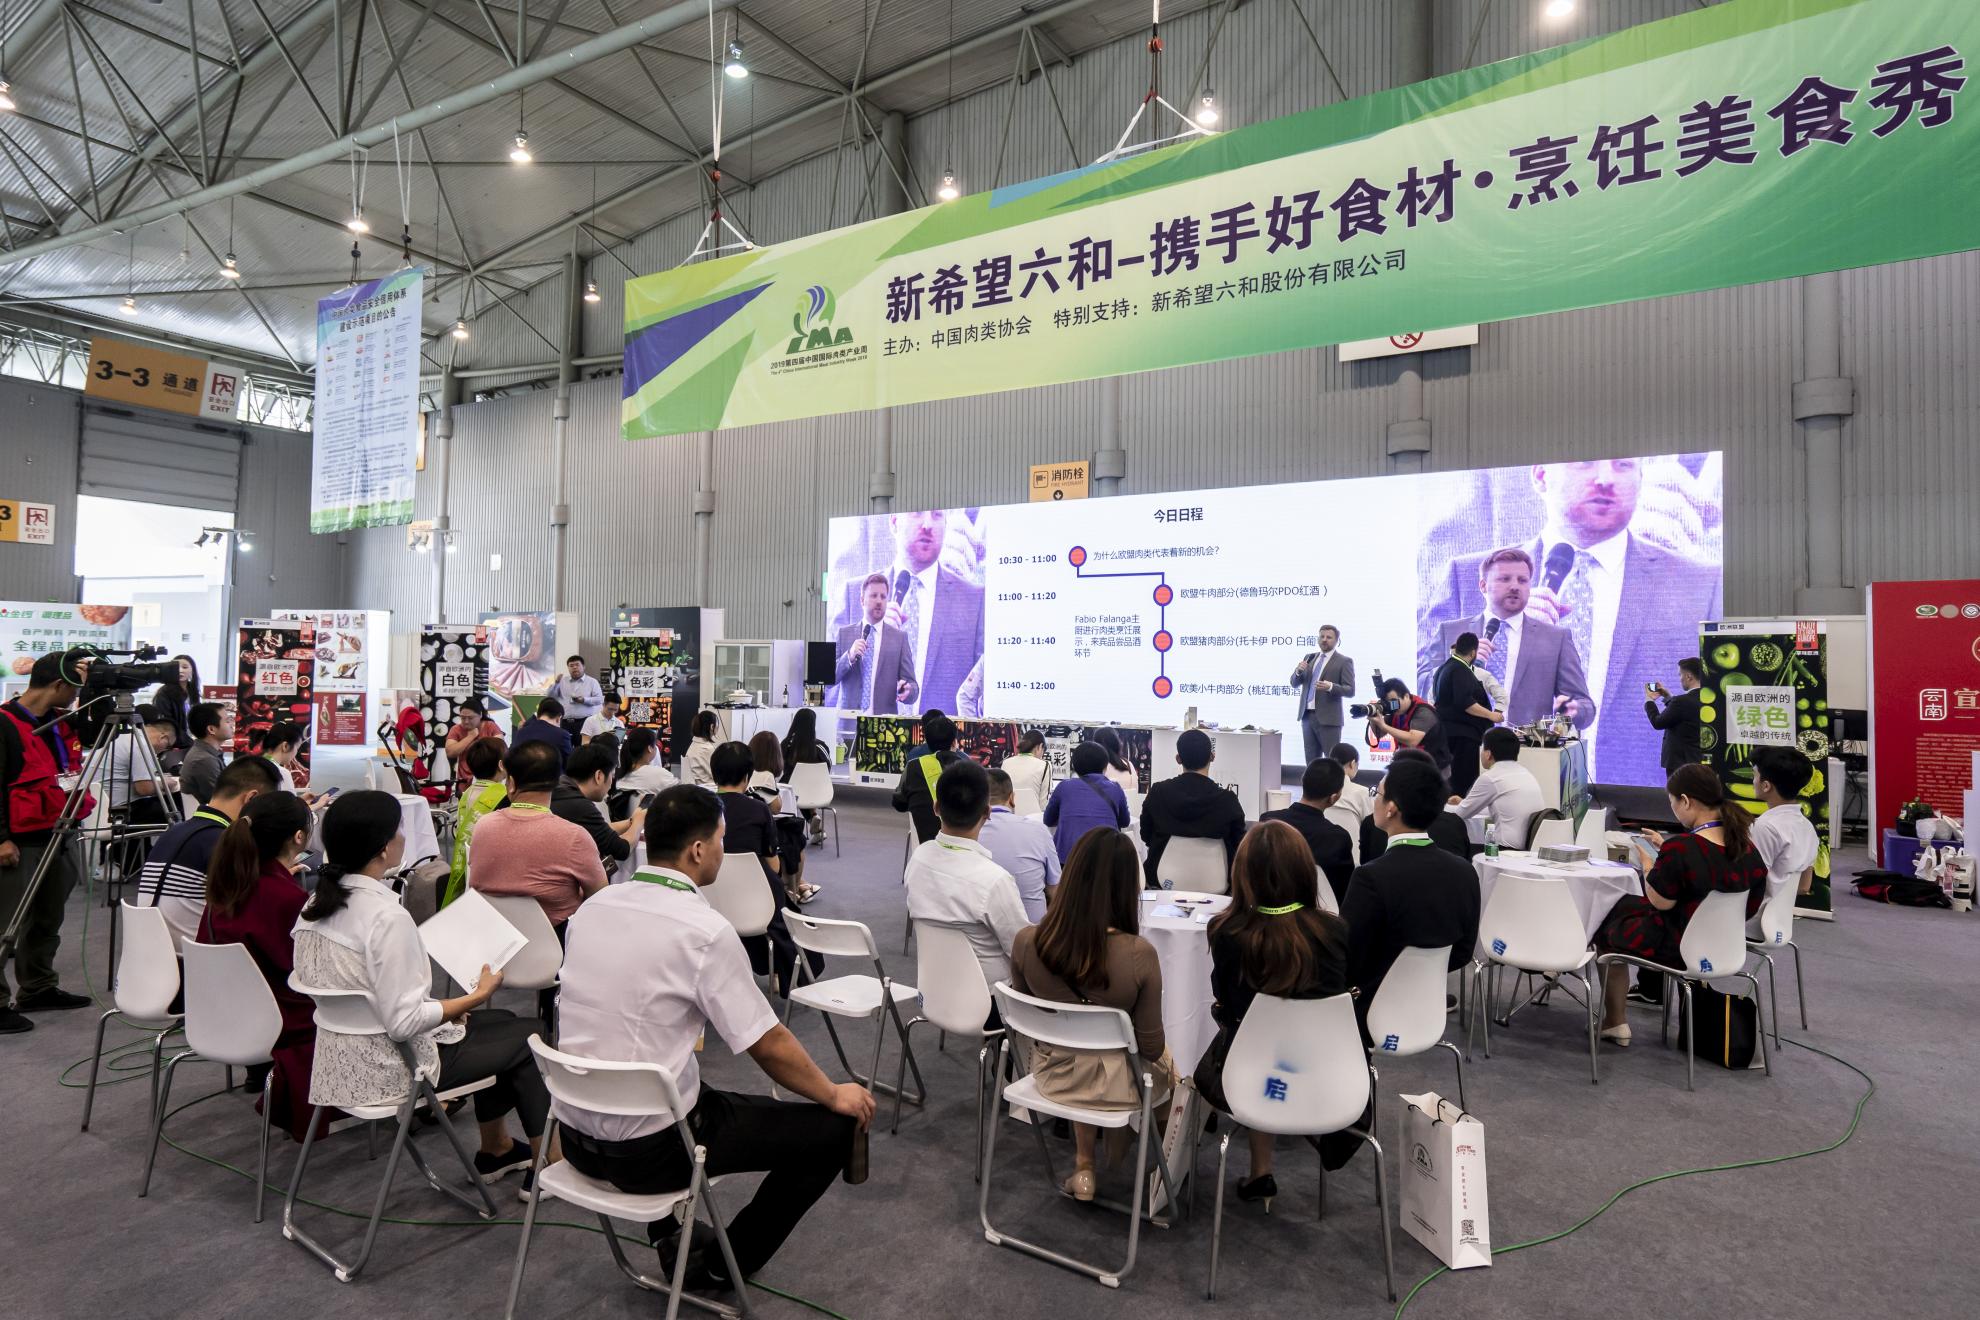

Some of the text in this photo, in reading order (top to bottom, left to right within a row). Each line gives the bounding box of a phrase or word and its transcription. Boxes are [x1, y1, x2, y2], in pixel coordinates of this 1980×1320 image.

[95, 360, 150, 387] 3-3
[162, 372, 199, 392] 通道
[210, 405, 230, 413] EXIT
[1051, 467, 1084, 481] 消防栓
[1154, 507, 1204, 523] 今日日程
[999, 556, 1023, 565] 10:30
[1031, 554, 1057, 563] 11:00
[1093, 546, 1220, 561] 为什么欧盟肉类代表着新的机会?
[998, 593, 1022, 601] 11:00
[1031, 592, 1056, 600] 11:20
[1074, 615, 1097, 624] Fabio
[997, 636, 1022, 645] 11:20
[1031, 636, 1056, 645] 11:40
[1271, 636, 1293, 646] PDO
[1074, 648, 1091, 658] 环节
[262, 671, 294, 684] 红色
[442, 673, 471, 686] 白色
[630, 676, 654, 689] 色彩
[997, 681, 1021, 689] 11:40
[1030, 681, 1055, 690] 12:00
[1179, 683, 1244, 695] 欧美小牛肉部分
[1731, 693, 1791, 703] 源自欧洲的
[1923, 692, 1943, 717] 云南
[1736, 706, 1790, 729] 绿色
[1740, 730, 1791, 740] 卓越的传统
[1381, 1034, 1400, 1051] 启
[1265, 1077, 1288, 1101] 启
